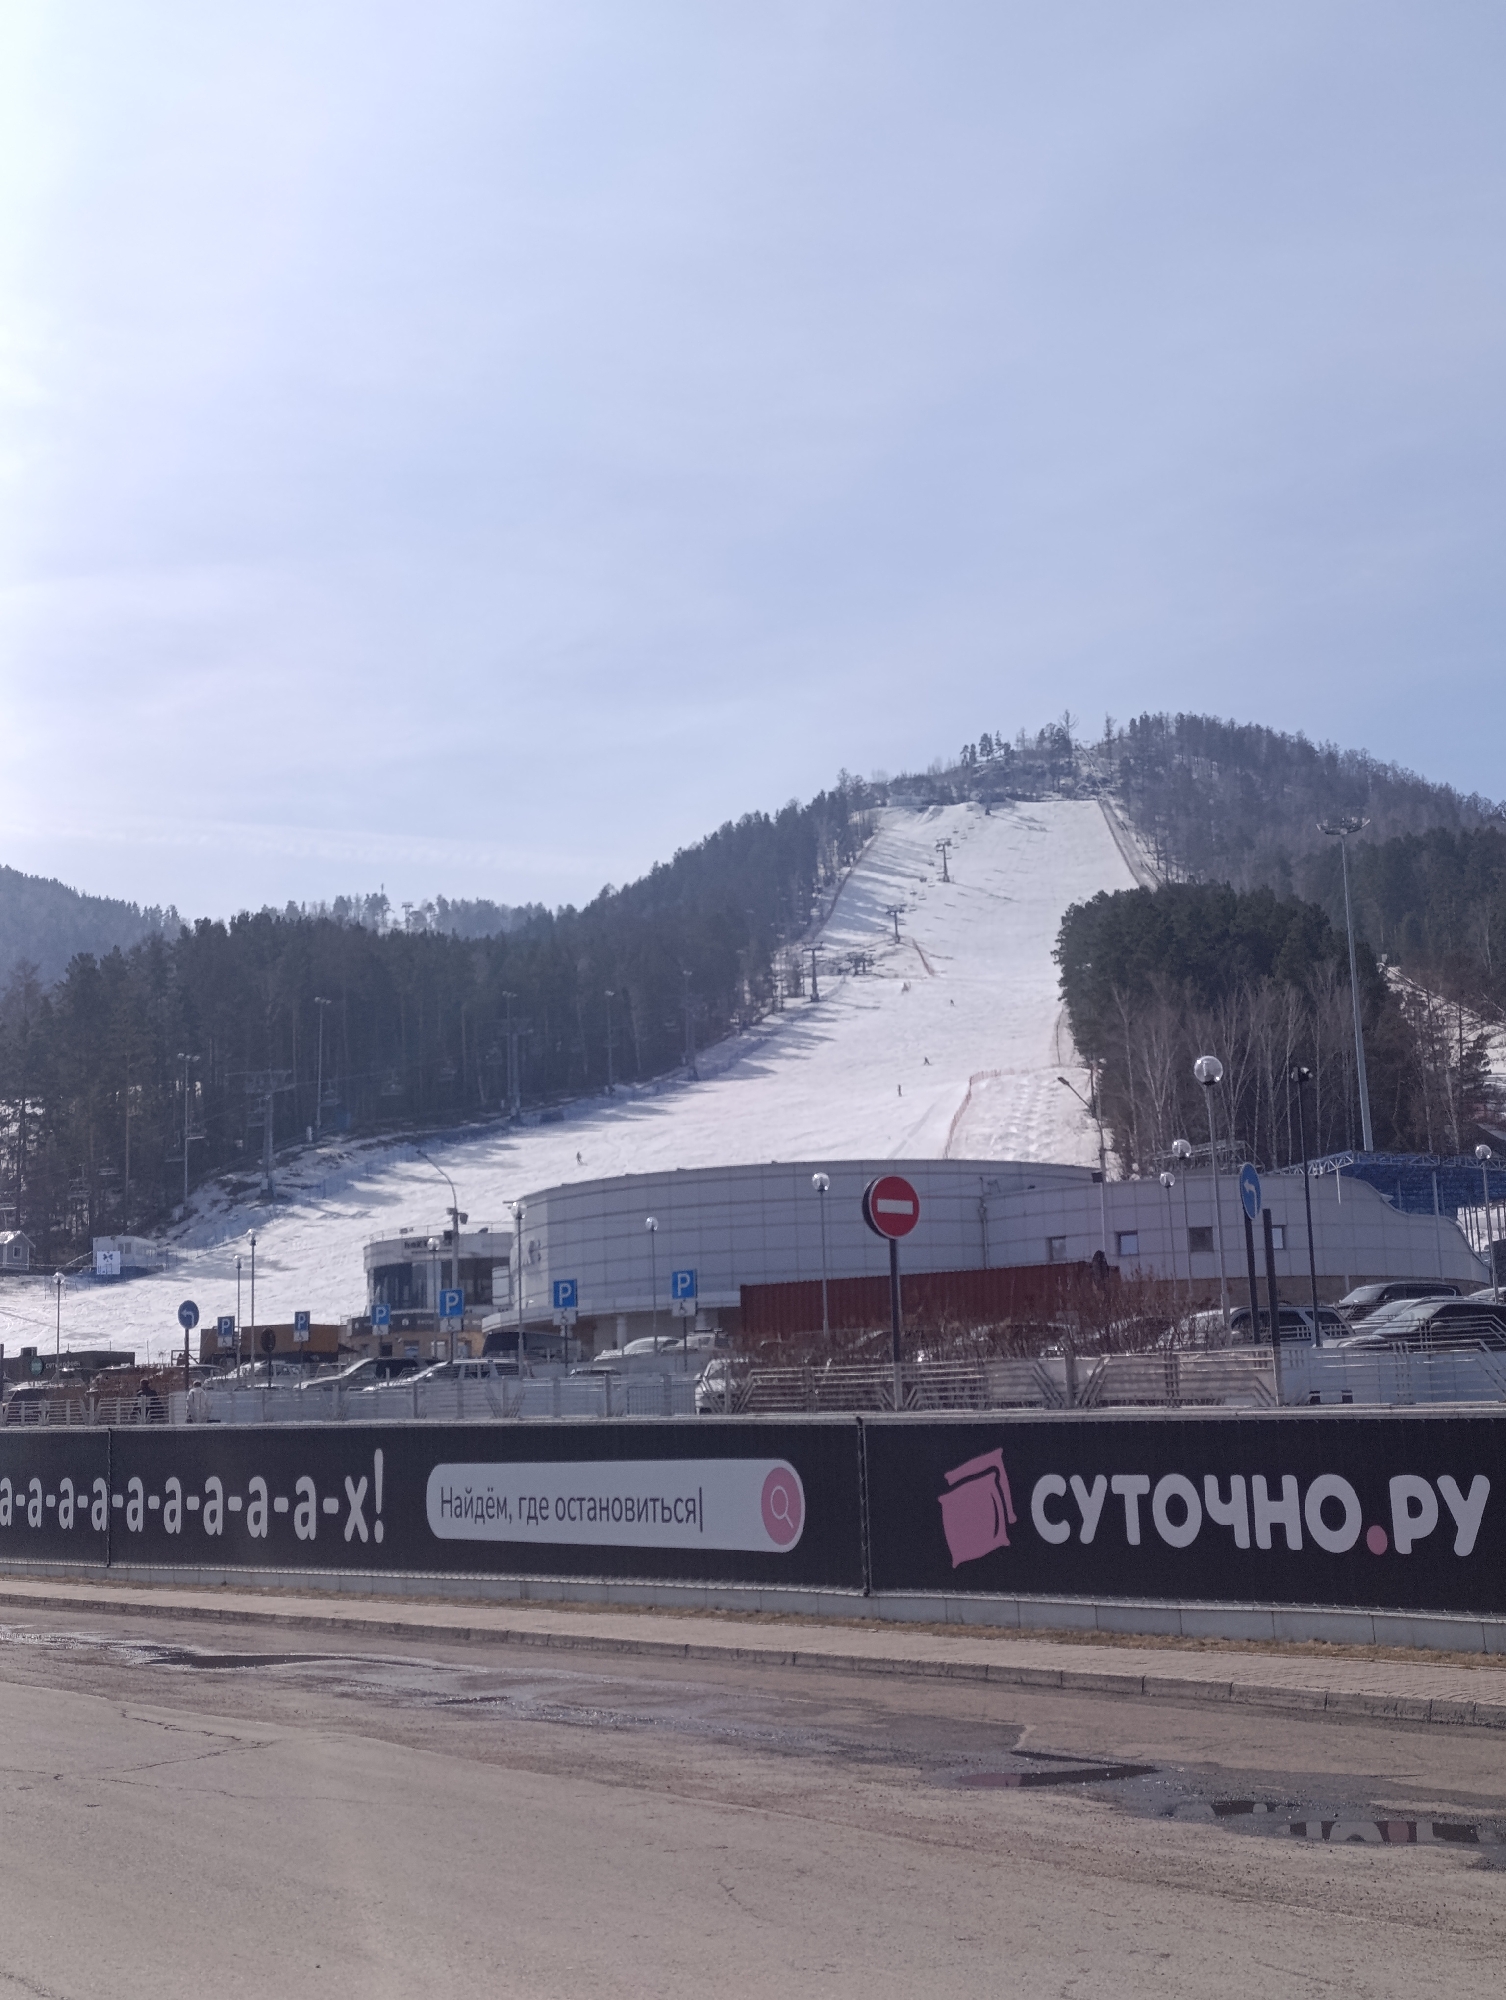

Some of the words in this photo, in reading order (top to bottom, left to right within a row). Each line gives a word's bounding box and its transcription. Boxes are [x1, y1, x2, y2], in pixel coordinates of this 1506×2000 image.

[440, 1486, 513, 1525] Найдём,
[518, 1496, 550, 1526] где
[554, 1496, 697, 1525] остановиться
[1030, 1473, 1491, 1557] СУТОЧНО.РУ
